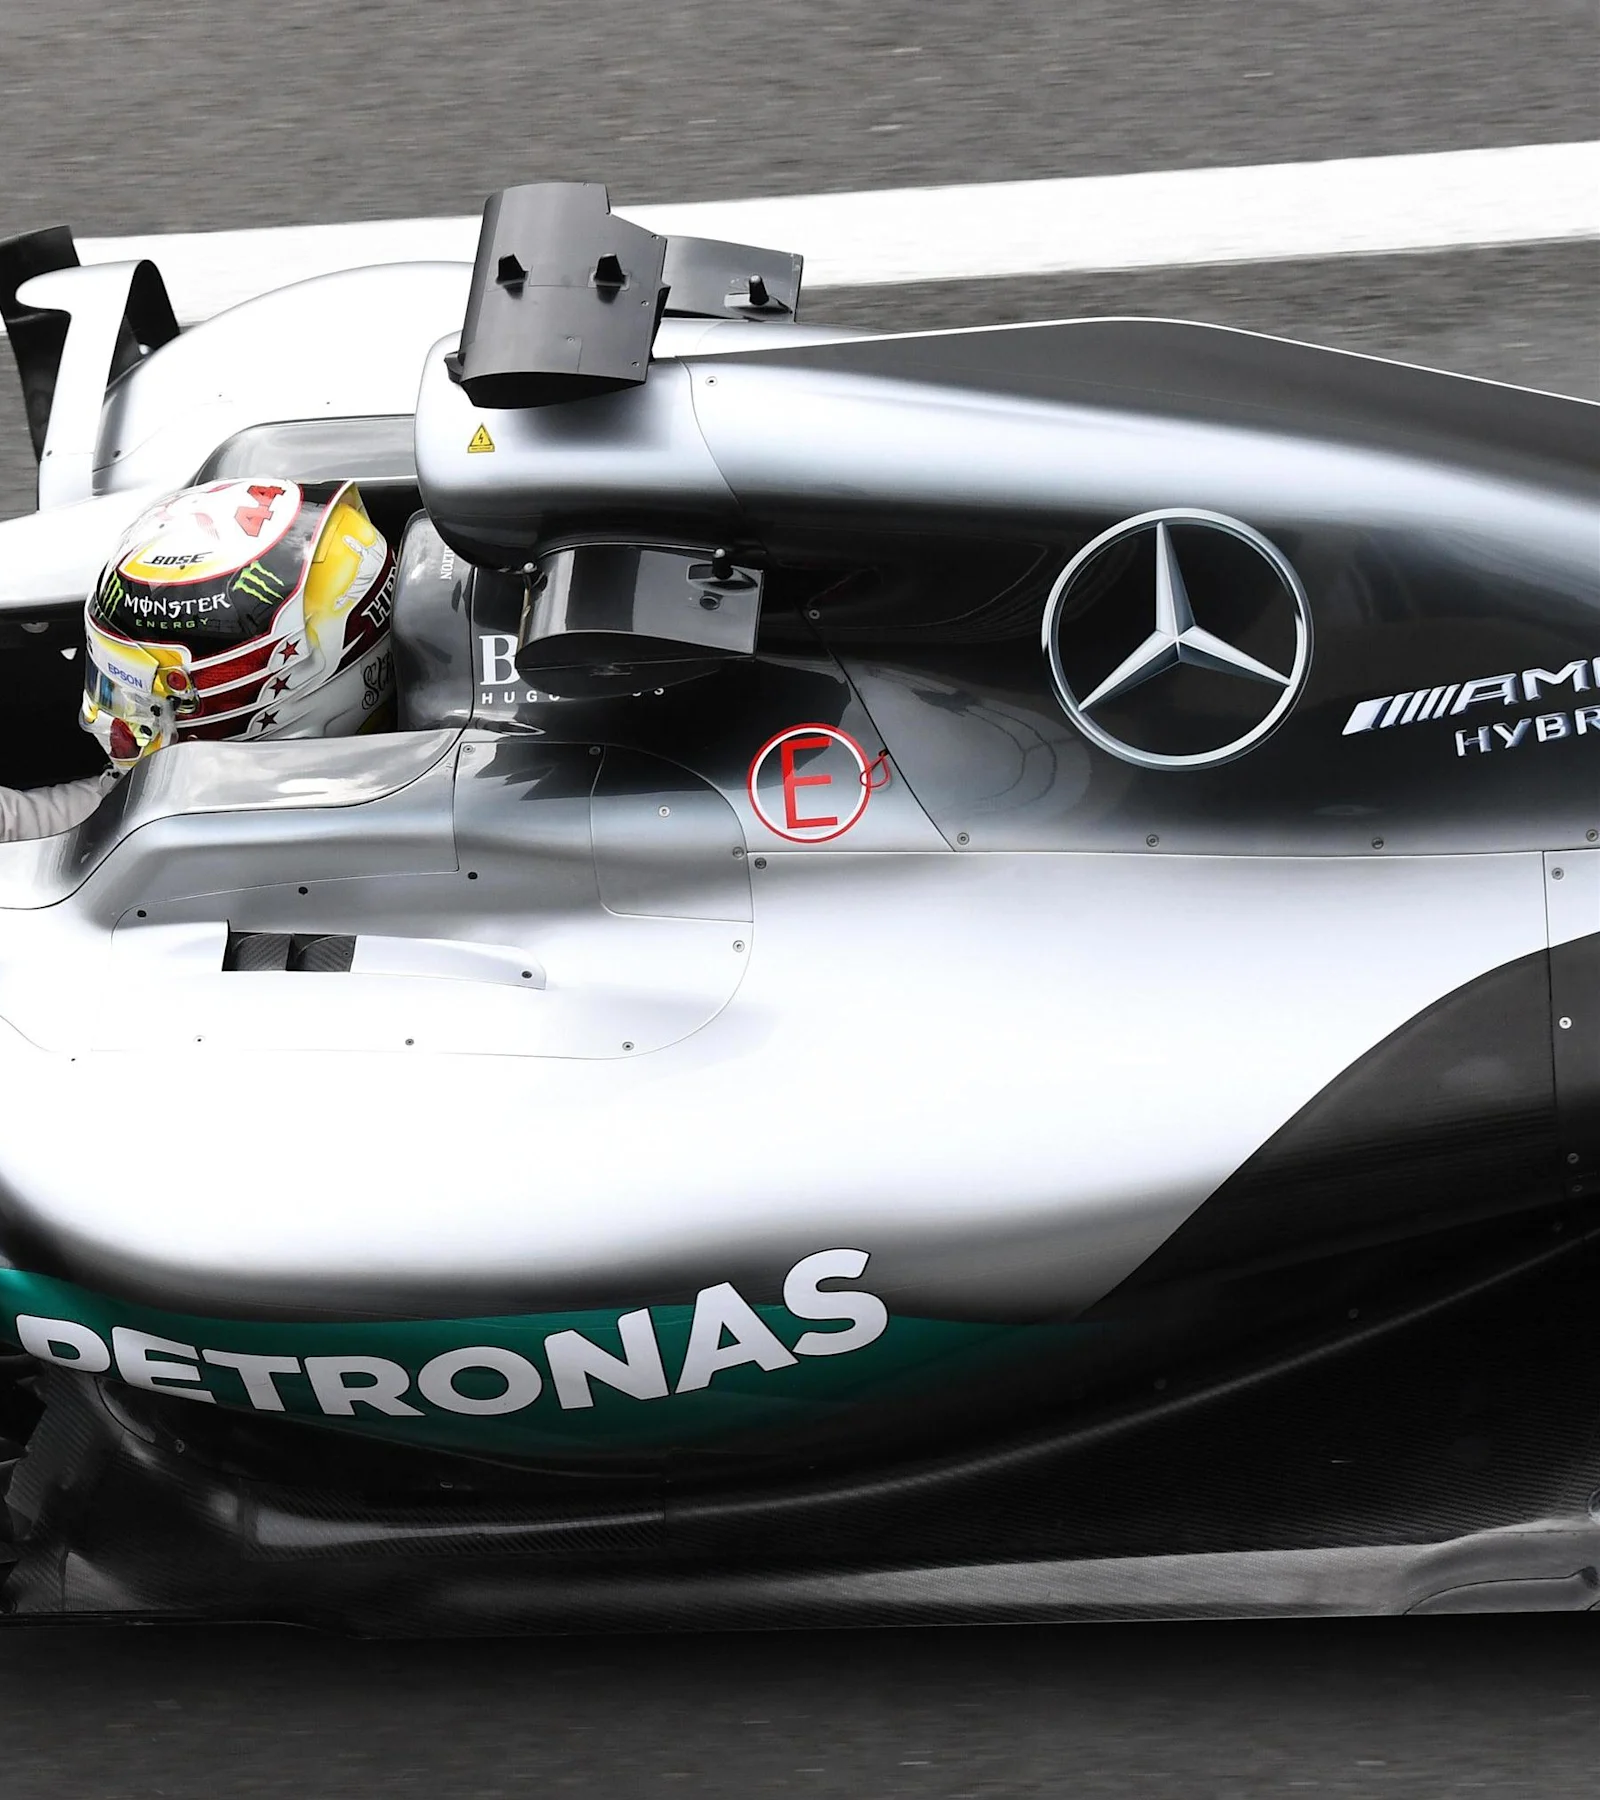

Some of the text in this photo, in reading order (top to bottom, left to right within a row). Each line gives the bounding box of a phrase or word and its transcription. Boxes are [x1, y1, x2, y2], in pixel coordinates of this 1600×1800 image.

[234, 485, 286, 537] 44
[144, 551, 212, 566] BOSE
[124, 592, 231, 618] MONSTER
[136, 617, 209, 630] ENERGY
[108, 662, 143, 688] EPSON
[1450, 656, 1600, 716] AM
[781, 737, 838, 829] E
[15, 1248, 889, 1417] PETRONAS
